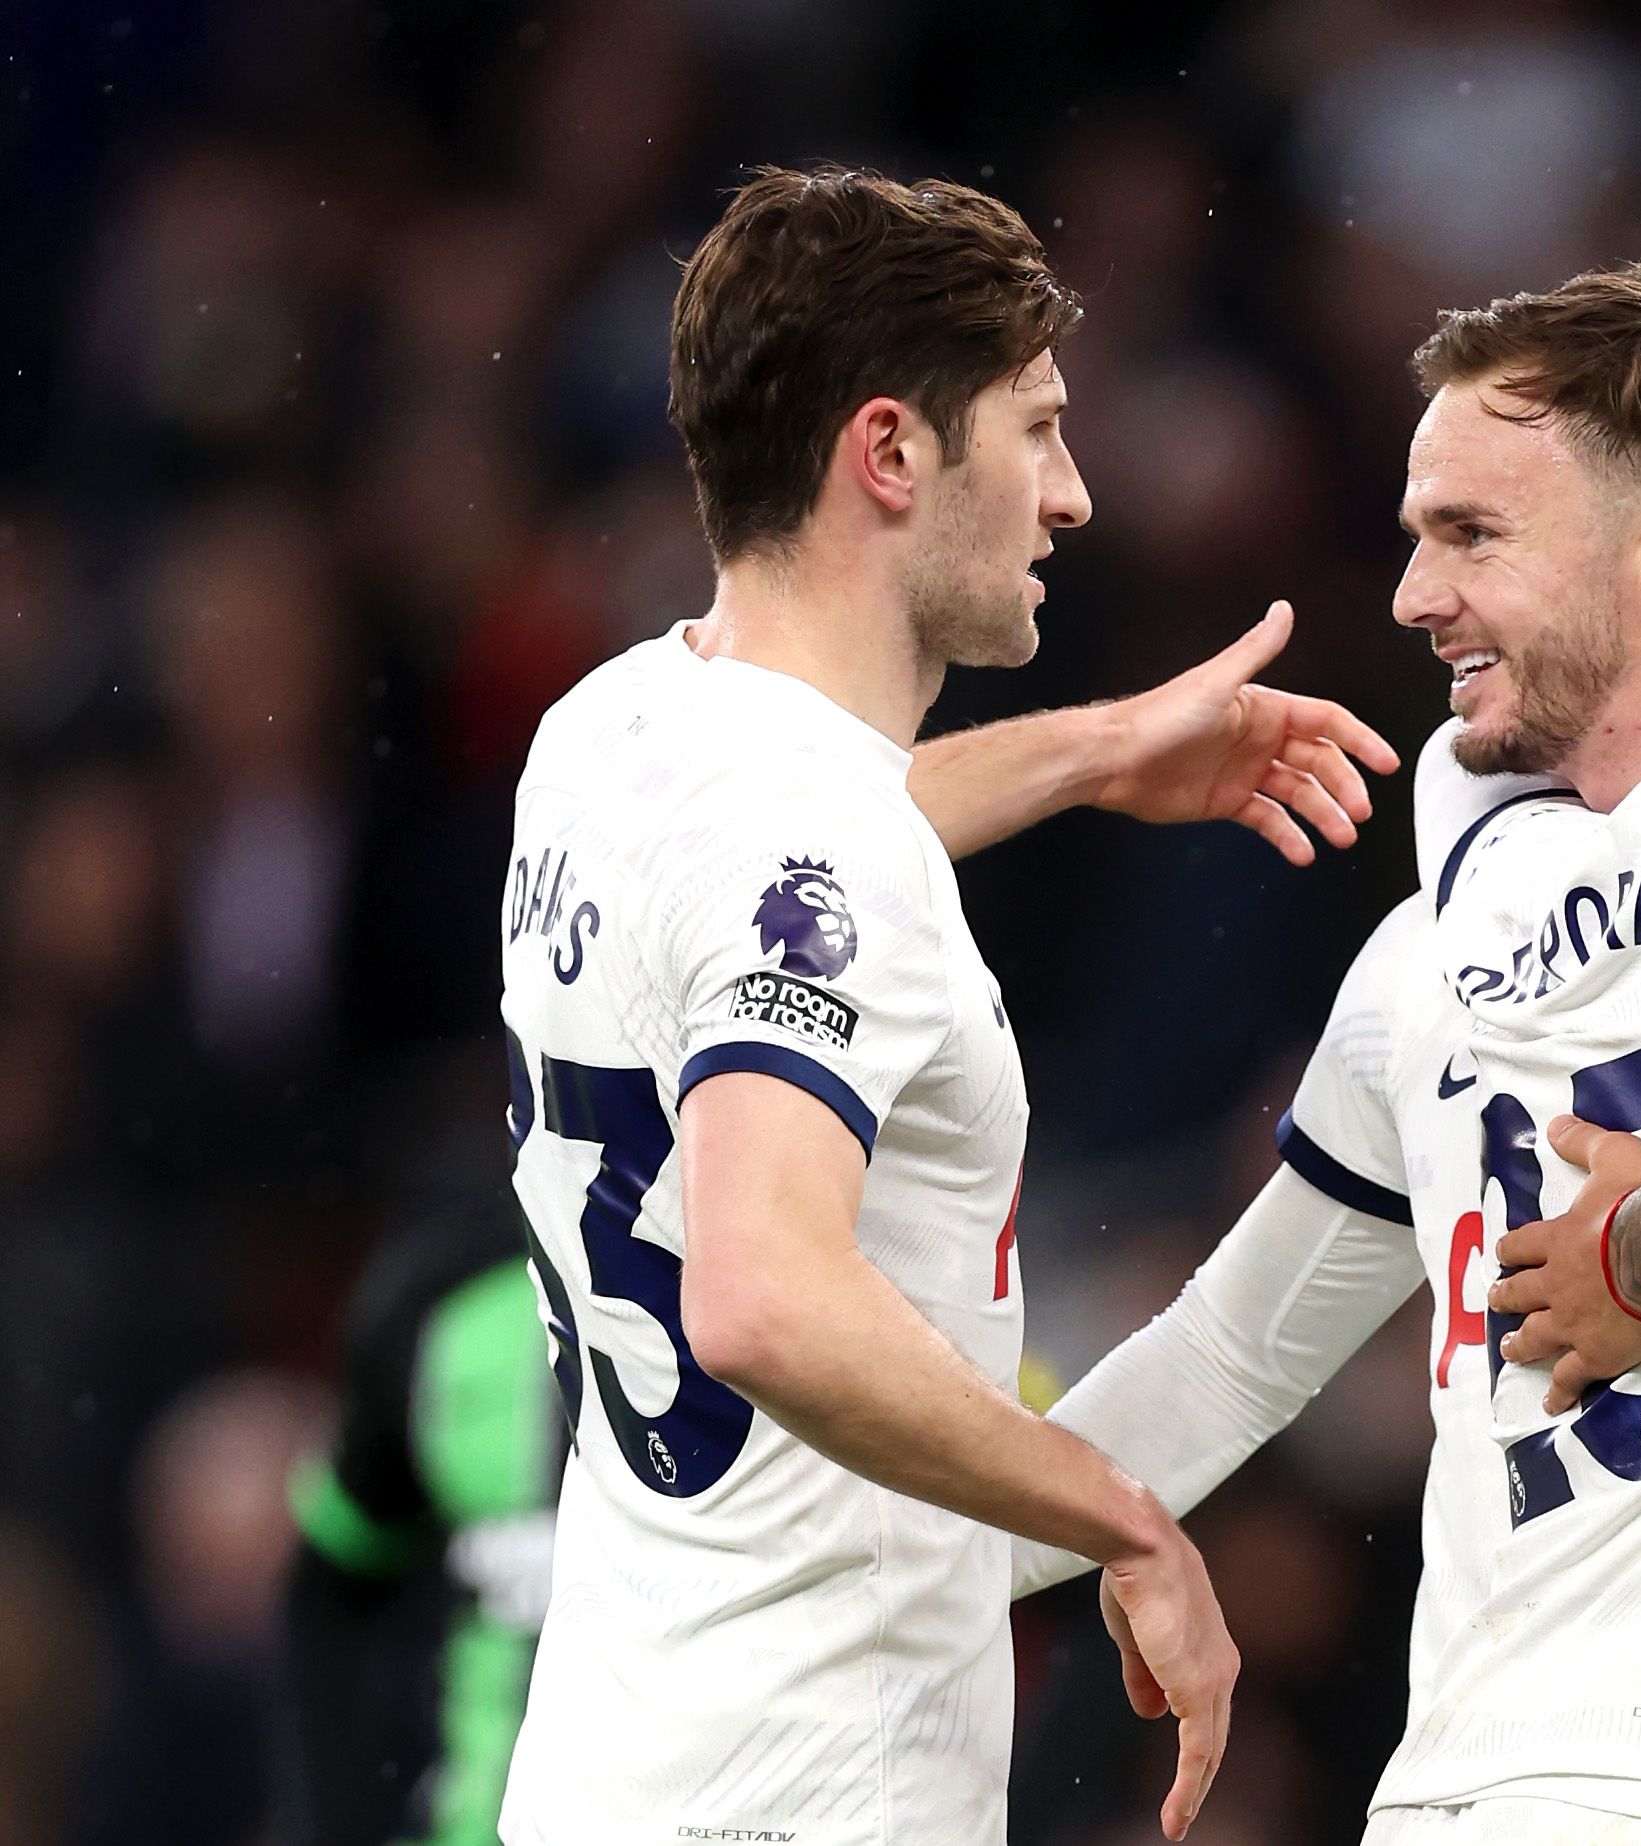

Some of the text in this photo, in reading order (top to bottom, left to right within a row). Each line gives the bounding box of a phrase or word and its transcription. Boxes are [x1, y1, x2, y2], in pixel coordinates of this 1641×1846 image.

[737, 973, 848, 1032] No room
[769, 1002, 848, 1050] racism
